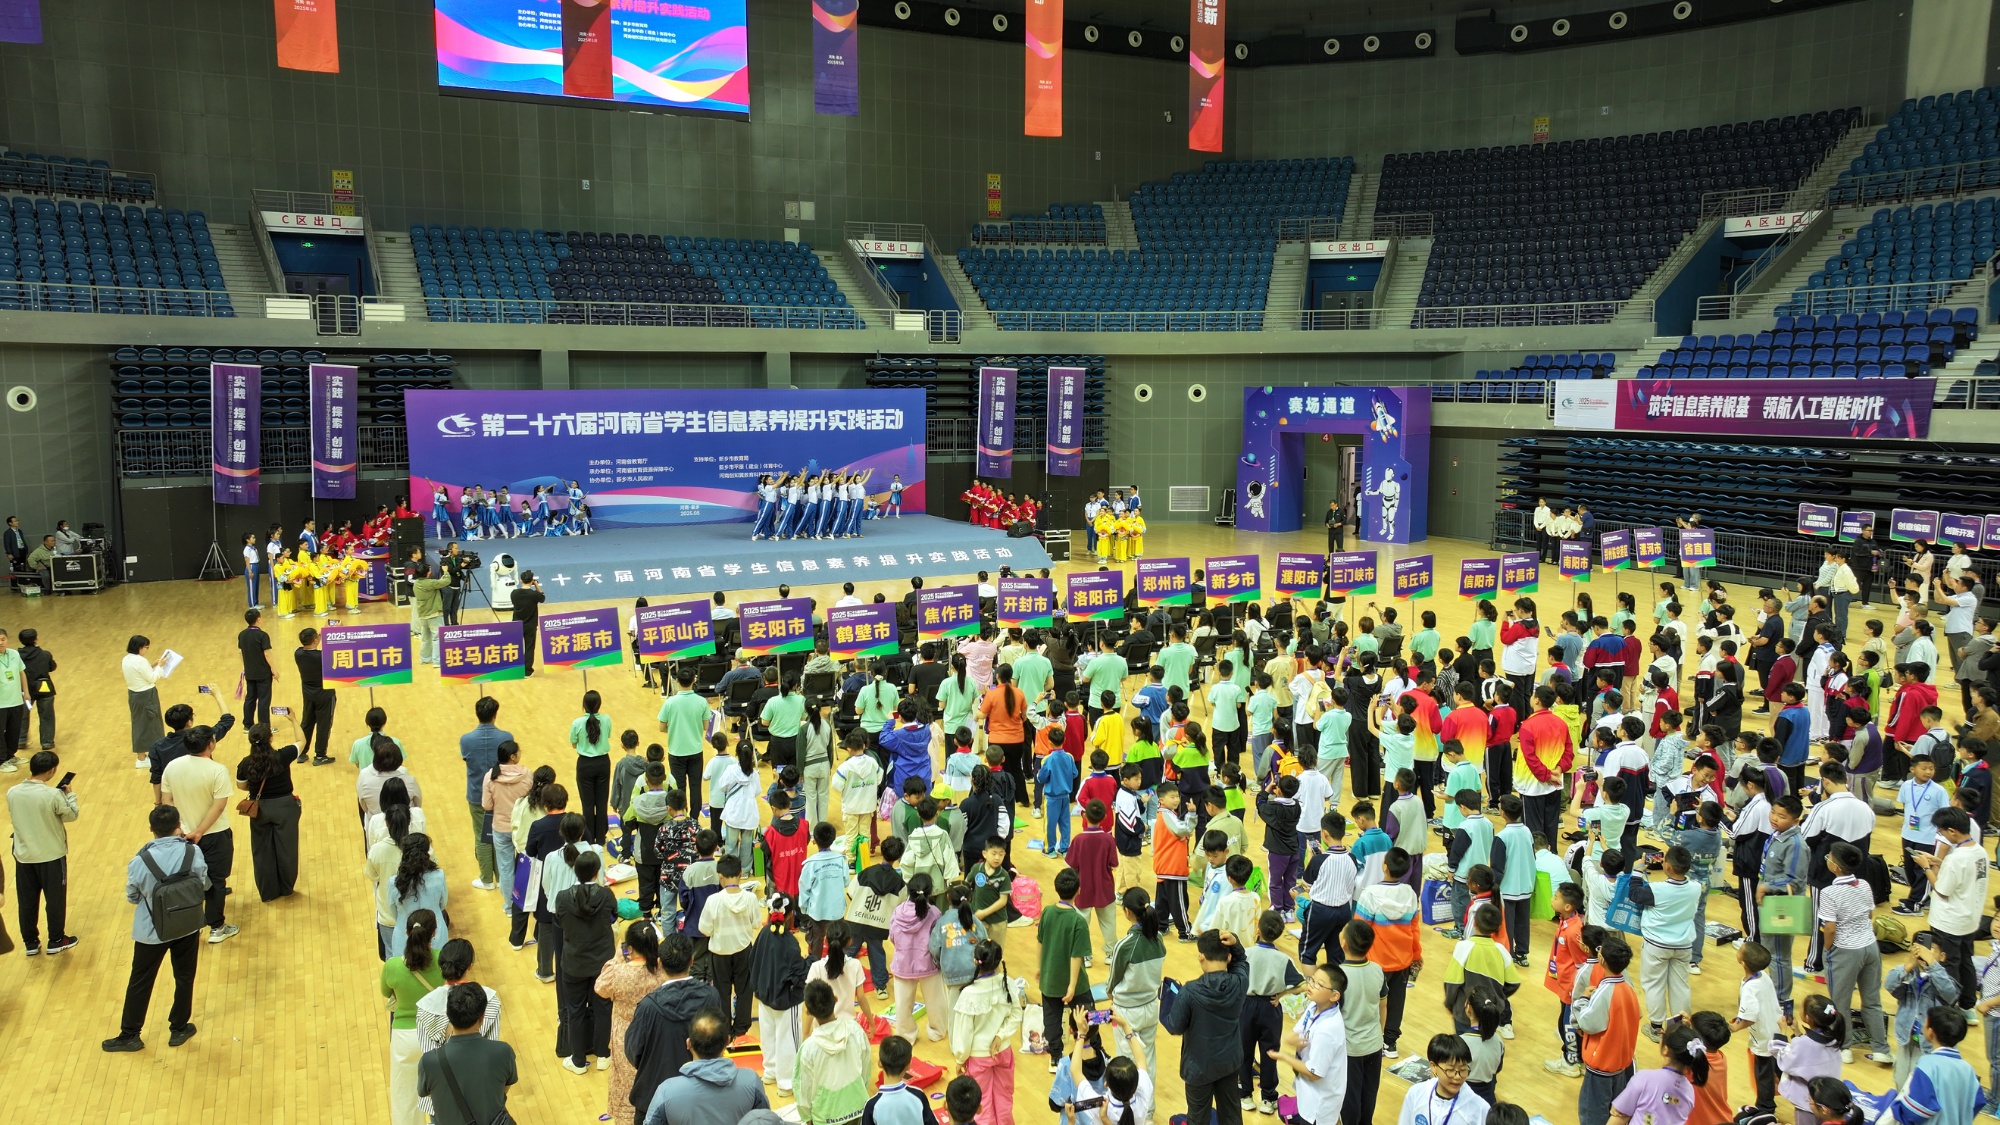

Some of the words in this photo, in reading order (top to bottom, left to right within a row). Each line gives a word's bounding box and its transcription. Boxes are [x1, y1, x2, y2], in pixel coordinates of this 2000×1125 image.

[281, 215, 342, 227] C区出口
[864, 242, 908, 252] C区出口
[1328, 242, 1374, 252] C区出口
[233, 375, 246, 400] 实践
[332, 376, 343, 399] 实践
[995, 376, 1006, 396] 实践
[1064, 376, 1074, 396] 实践
[994, 401, 1005, 421] 探索
[1063, 400, 1073, 420] 探索
[1288, 396, 1356, 415] 赛场通道
[1648, 394, 1751, 418] 筑牢信息素养根基
[1763, 395, 1886, 421] 领航人工智能时代
[233, 407, 246, 432] 探索
[332, 406, 343, 429] 探索
[481, 408, 904, 437] 第二十六届河南省学生信息素养提升实践活动
[993, 426, 1003, 446] 创新
[1061, 425, 1072, 444] 创新
[1322, 433, 1329, 442] 4
[233, 439, 246, 464] 创新
[331, 436, 343, 460] 创新
[1639, 541, 1662, 556] 漯河市
[1562, 555, 1589, 570] 南阳市
[1143, 572, 1186, 593] 郑州市
[1211, 571, 1256, 590] 新乡市
[1280, 569, 1319, 585] 濮阳市
[1333, 567, 1375, 583] 三门峡市
[1397, 571, 1429, 590] 商丘市
[1463, 574, 1496, 589] 信阳市
[1505, 567, 1536, 583] 许昌市
[920, 593, 935, 601] 2025
[1003, 595, 1048, 613] 开封市
[1073, 588, 1119, 607] 洛阳市
[640, 611, 657, 620] 2025
[743, 606, 759, 615] 2025
[831, 611, 847, 619] 2025
[924, 603, 974, 625] 焦作市
[544, 619, 562, 628] 2025
[642, 620, 710, 646] 平顶山市
[748, 617, 806, 640] 安阳市
[836, 622, 891, 644] 鹤壁市
[326, 632, 346, 641] 2025
[443, 630, 463, 639] 2025
[550, 629, 613, 655] 济源市
[331, 646, 403, 670] 周口市
[445, 643, 519, 668] 驻马店市
